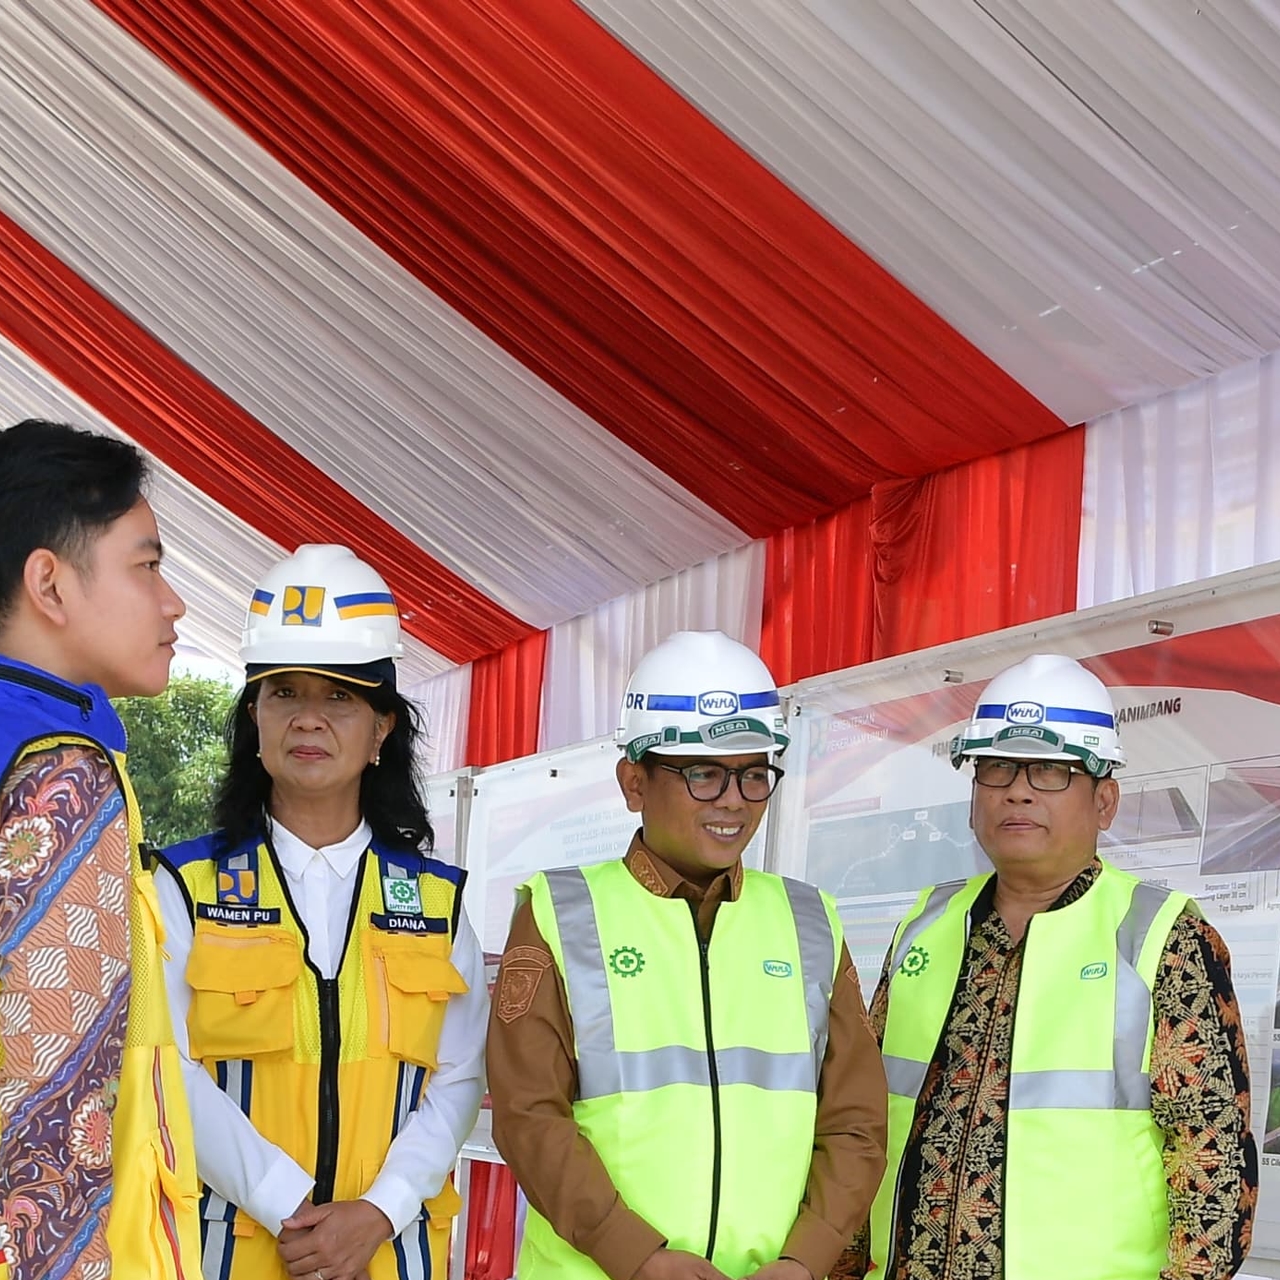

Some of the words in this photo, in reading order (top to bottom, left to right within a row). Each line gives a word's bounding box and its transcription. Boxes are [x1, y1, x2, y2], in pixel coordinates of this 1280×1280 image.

[207, 908, 250, 920] WAMEN
[254, 909, 270, 921] PU
[389, 918, 426, 930] DIANA
